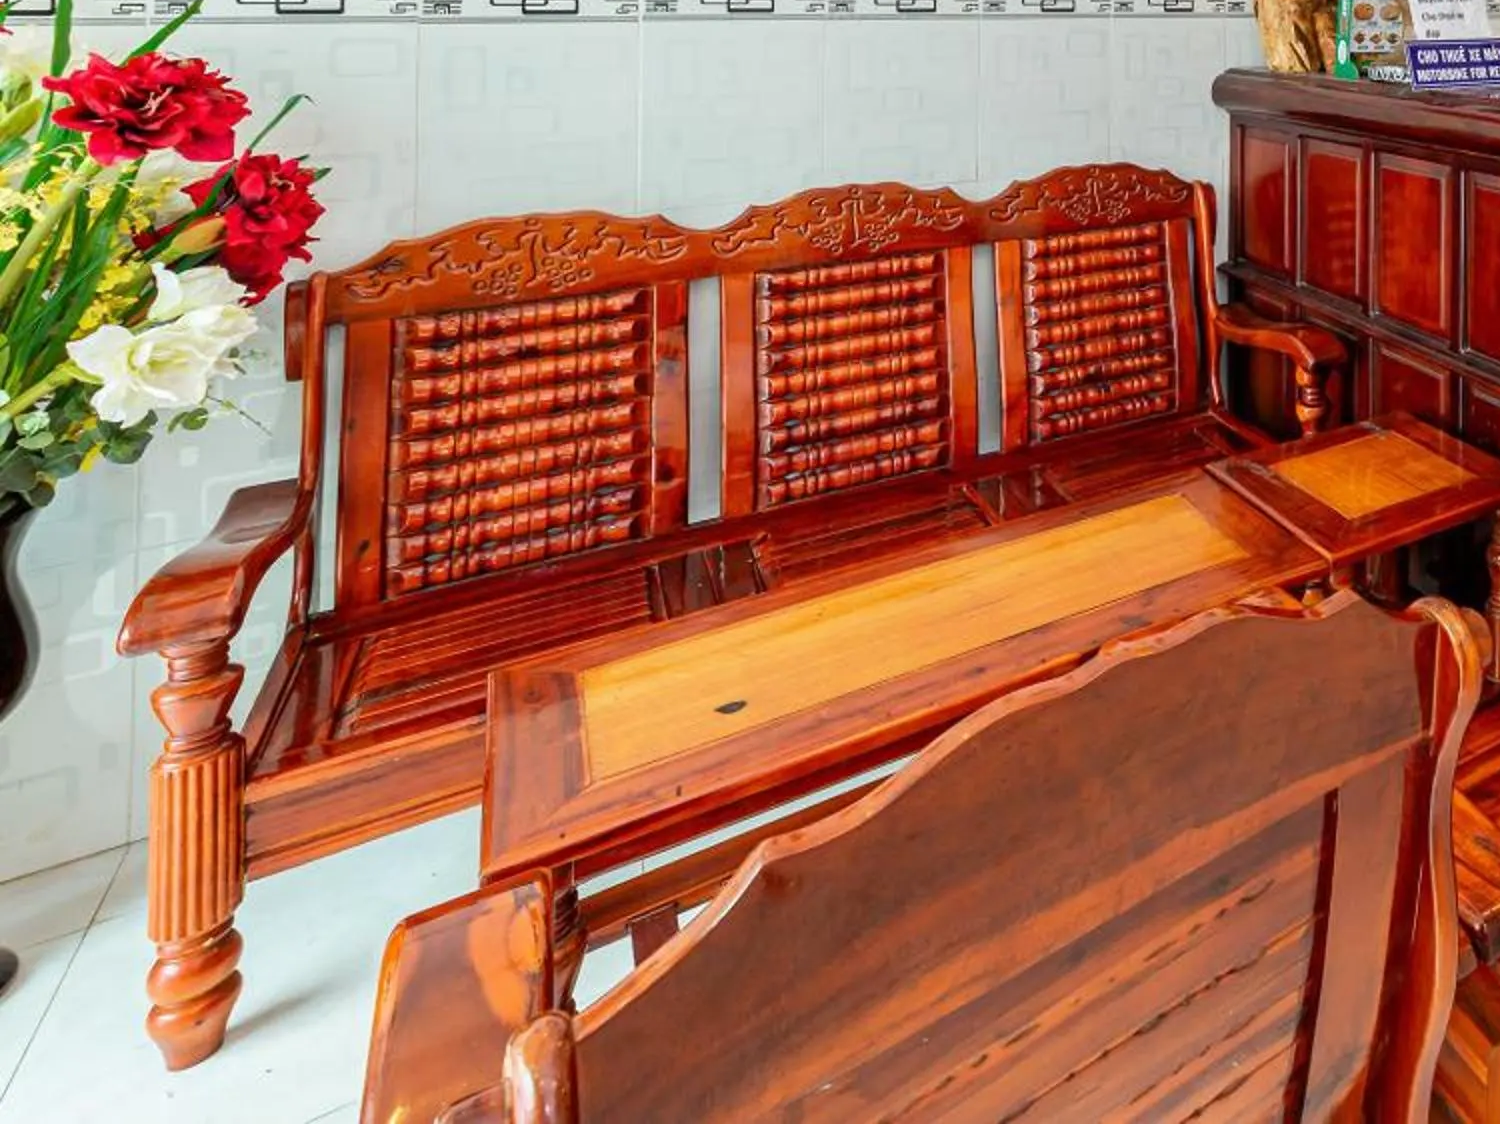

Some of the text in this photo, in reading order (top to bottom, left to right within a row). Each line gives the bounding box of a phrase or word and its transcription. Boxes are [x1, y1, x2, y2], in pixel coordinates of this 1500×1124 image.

[1418, 49, 1438, 64] CHO
[1468, 48, 1482, 62] XE
[1470, 67, 1488, 79] FOR
